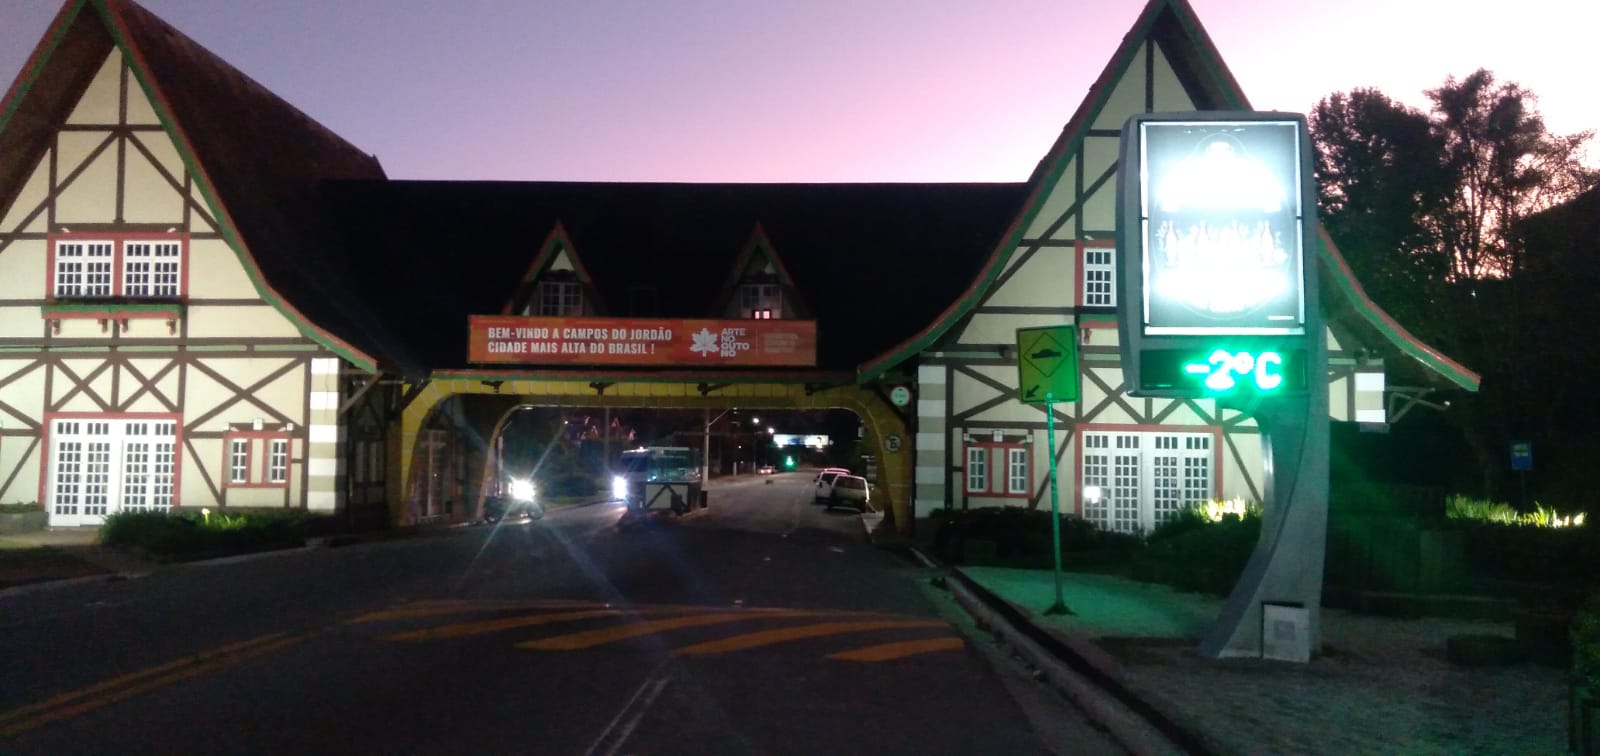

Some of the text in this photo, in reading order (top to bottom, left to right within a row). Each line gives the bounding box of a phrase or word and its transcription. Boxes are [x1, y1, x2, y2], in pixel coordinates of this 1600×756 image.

[488, 326, 672, 341] BEM-VINDO A CAMPOS DO JORDÃO
[721, 328, 746, 336] ARTE
[721, 335, 735, 343] NO
[487, 341, 527, 353] CIDADE
[531, 342, 558, 353] MAIS
[561, 342, 586, 353] ALTA
[590, 343, 605, 354] DO
[608, 343, 647, 354] BRASIL
[721, 342, 750, 350] OUTO
